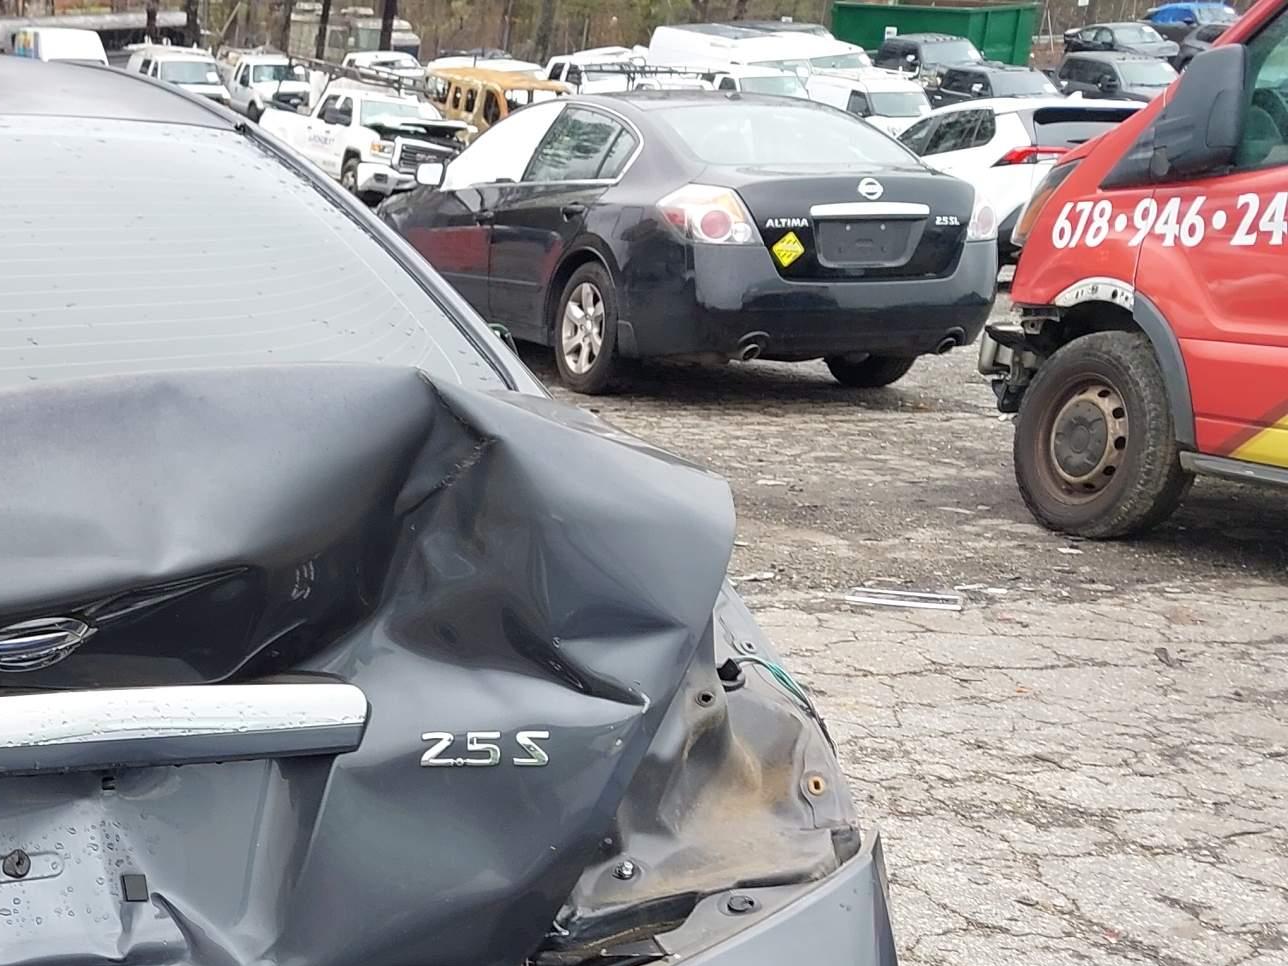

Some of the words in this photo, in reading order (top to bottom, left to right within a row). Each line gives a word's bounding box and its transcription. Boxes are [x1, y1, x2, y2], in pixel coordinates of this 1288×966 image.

[765, 218, 809, 228] ALTIMA
[420, 731, 501, 767] 2.5
[515, 730, 550, 767] S
